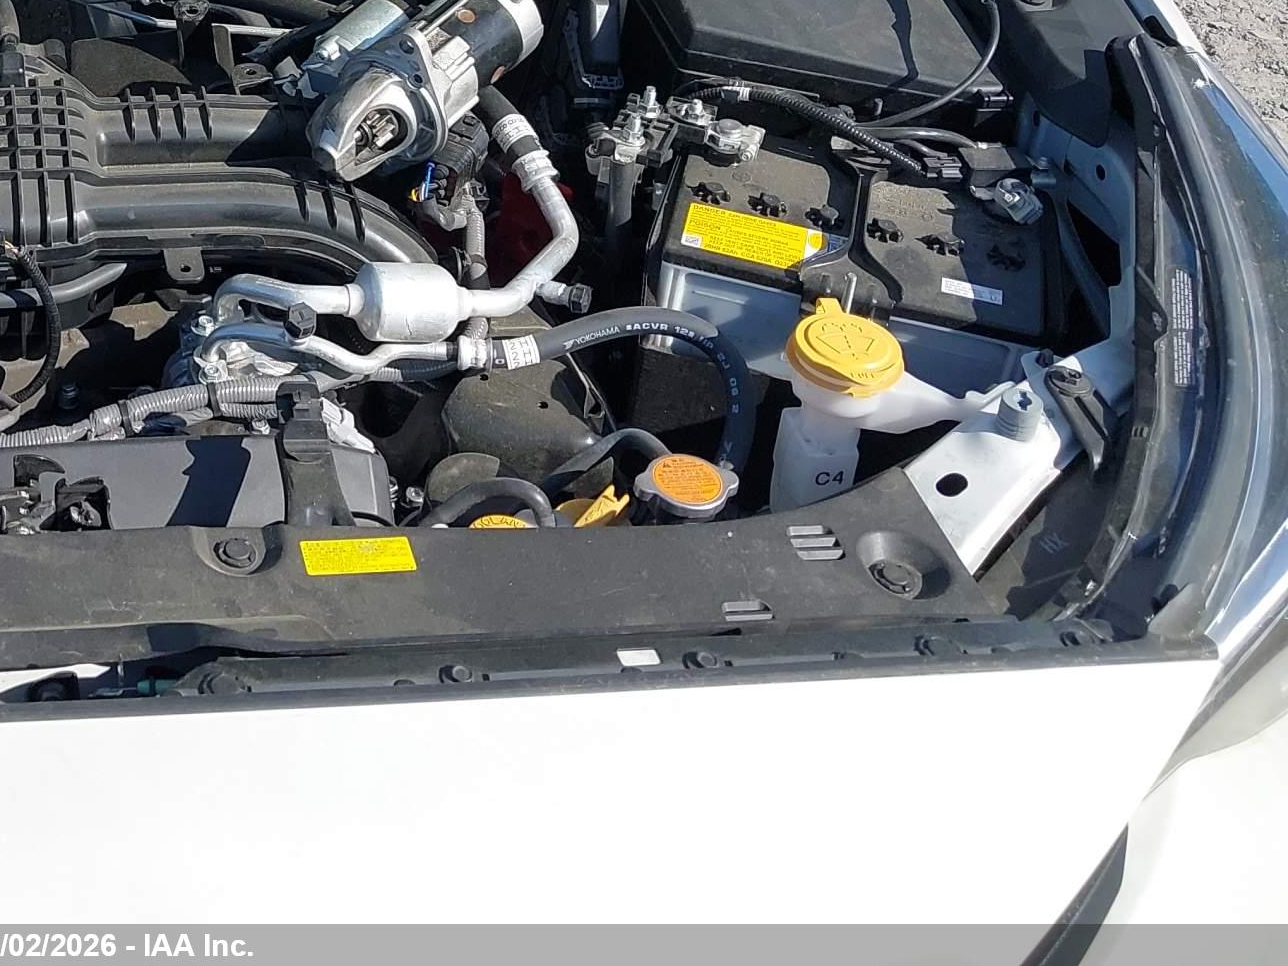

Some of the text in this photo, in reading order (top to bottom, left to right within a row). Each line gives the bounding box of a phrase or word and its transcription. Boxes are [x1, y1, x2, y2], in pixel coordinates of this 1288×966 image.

[693, 204, 726, 215] DANGER
[689, 219, 721, 231] POISON
[575, 325, 621, 345] YOKOHAMA
[815, 470, 844, 486] C4
